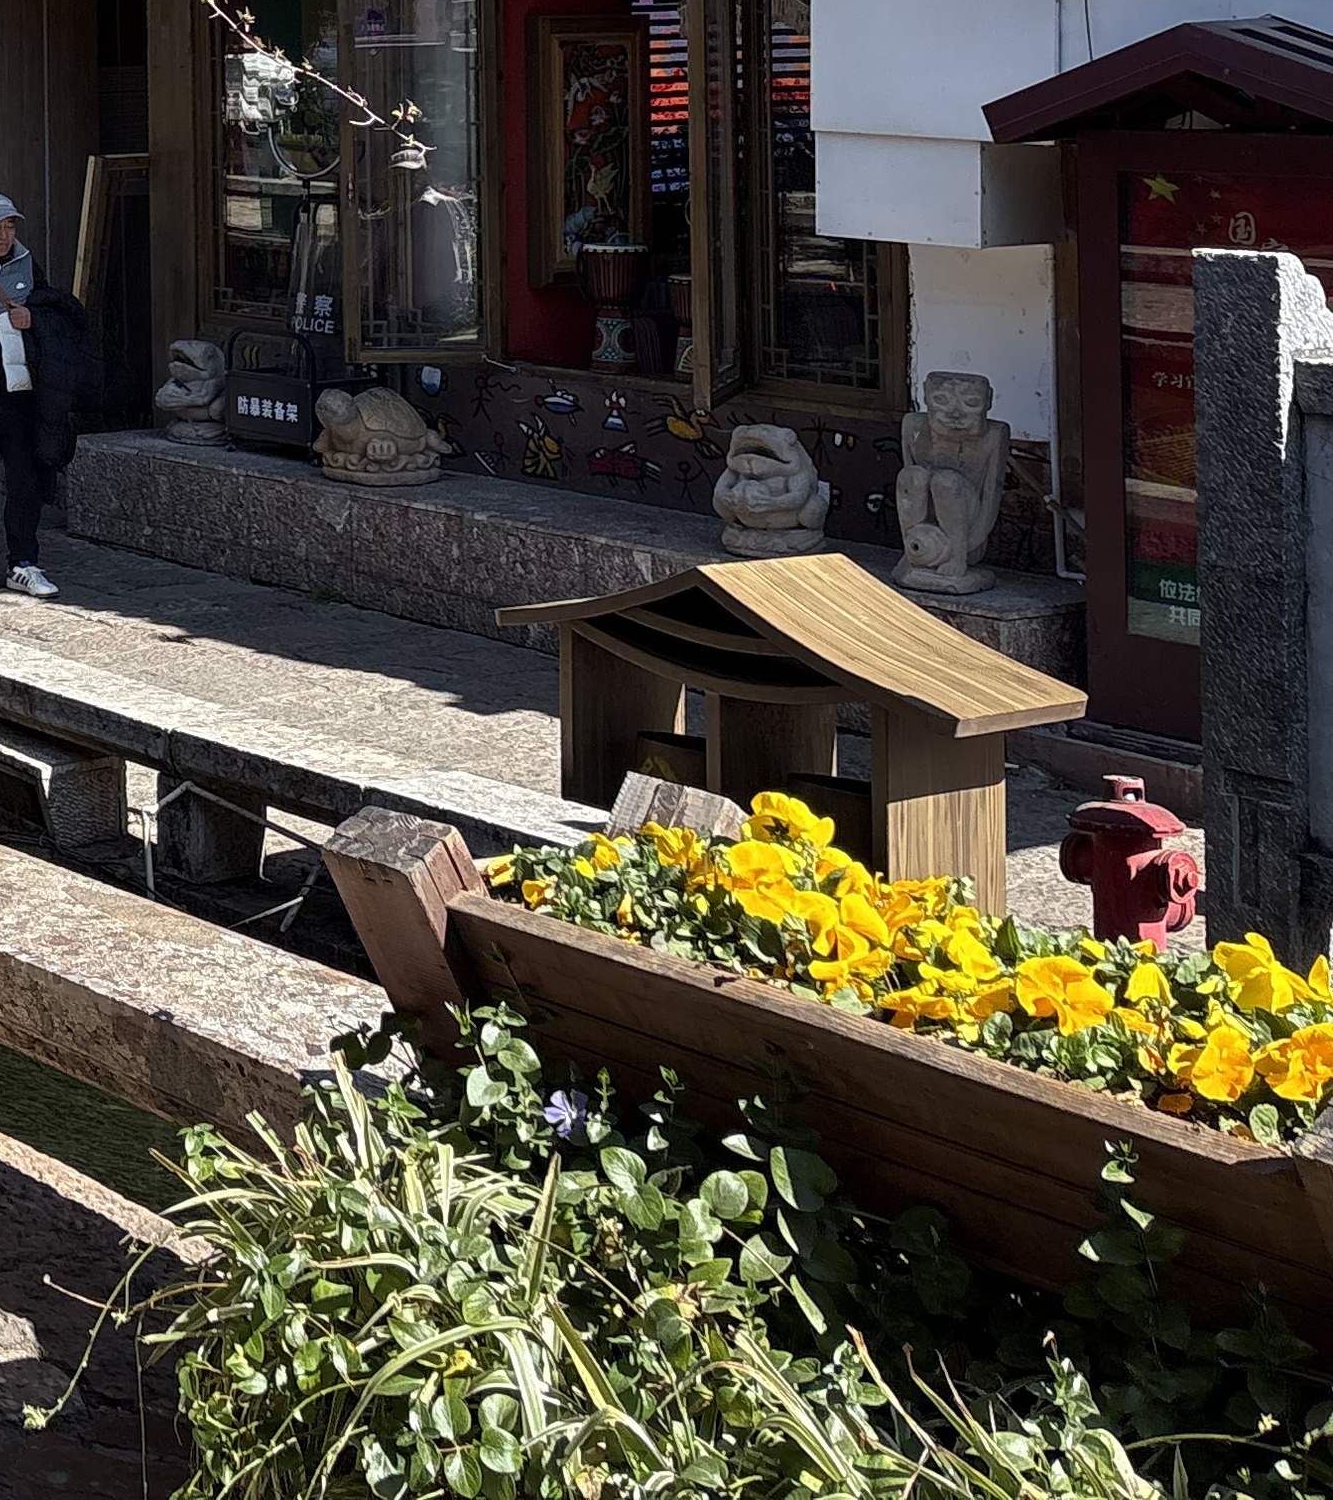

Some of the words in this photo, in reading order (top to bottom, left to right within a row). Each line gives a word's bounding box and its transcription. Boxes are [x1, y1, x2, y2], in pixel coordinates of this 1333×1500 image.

[295, 292, 333, 317] 警察
[291, 316, 334, 334] POLICE
[237, 396, 298, 423] 防暴装备架
[1158, 578, 1200, 602] 依法
